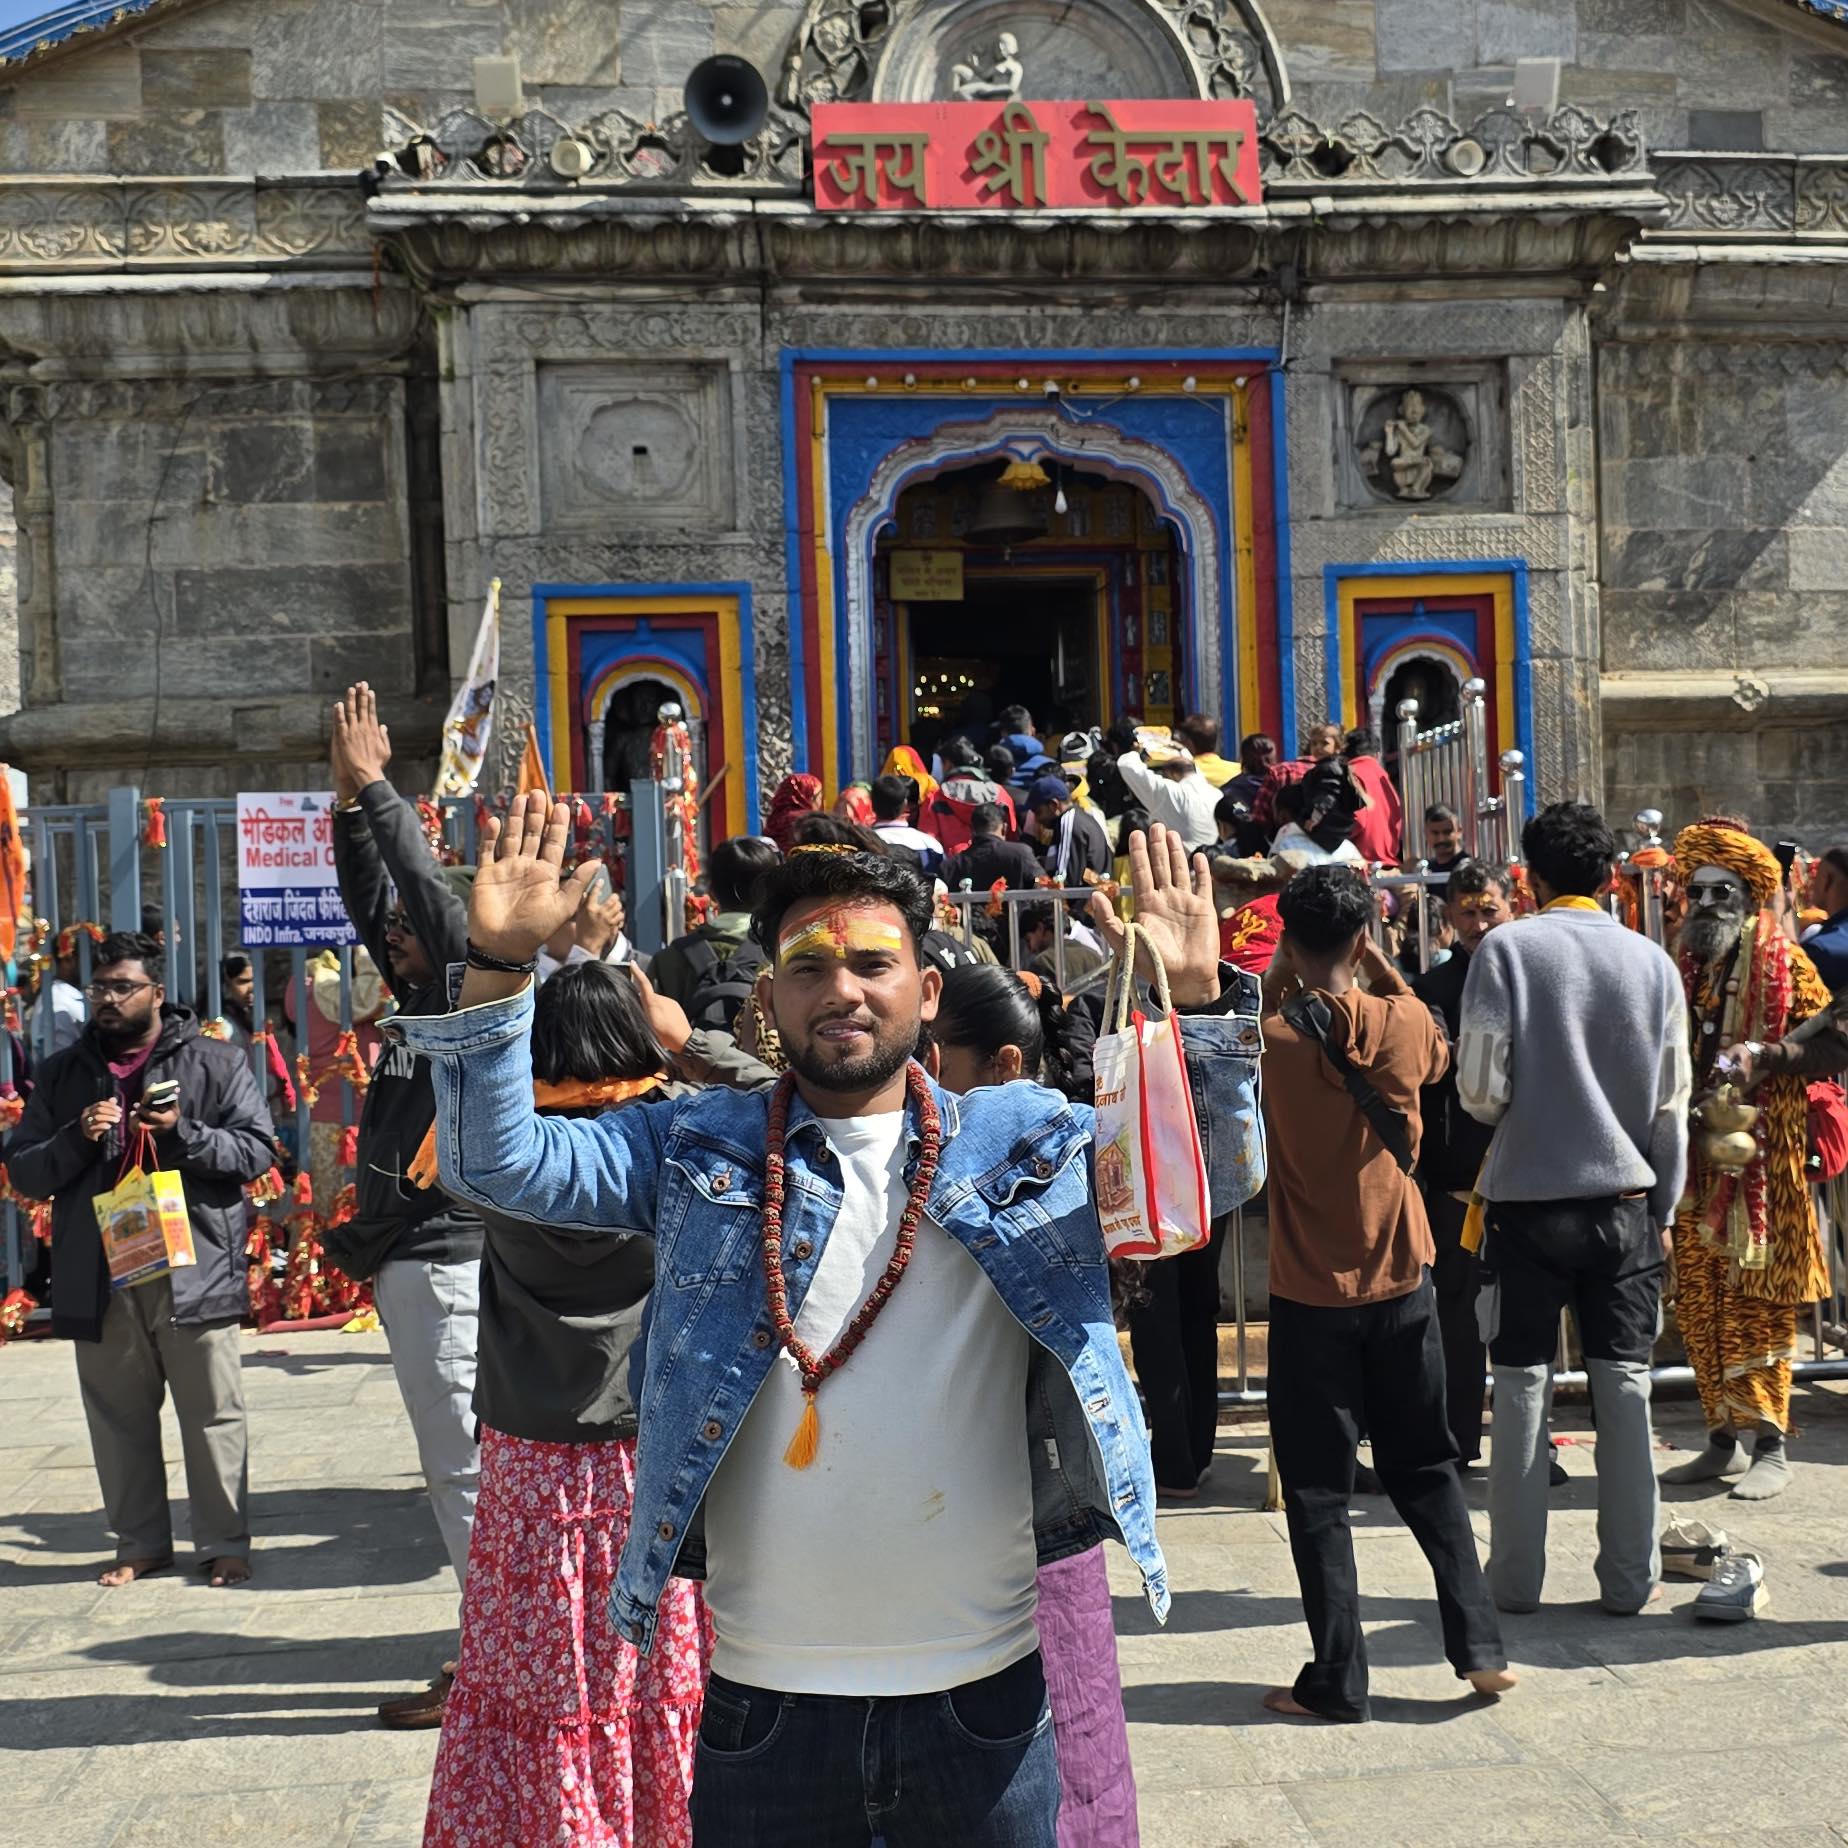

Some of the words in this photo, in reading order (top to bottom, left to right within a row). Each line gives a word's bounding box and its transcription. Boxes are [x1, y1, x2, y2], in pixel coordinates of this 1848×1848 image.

[827, 133, 929, 206] जय
[971, 102, 1049, 206] श्री
[1088, 102, 1248, 204] केदार
[240, 808, 305, 845] मेडिकल
[246, 847, 318, 867] Medical
[243, 926, 272, 944] INDO
